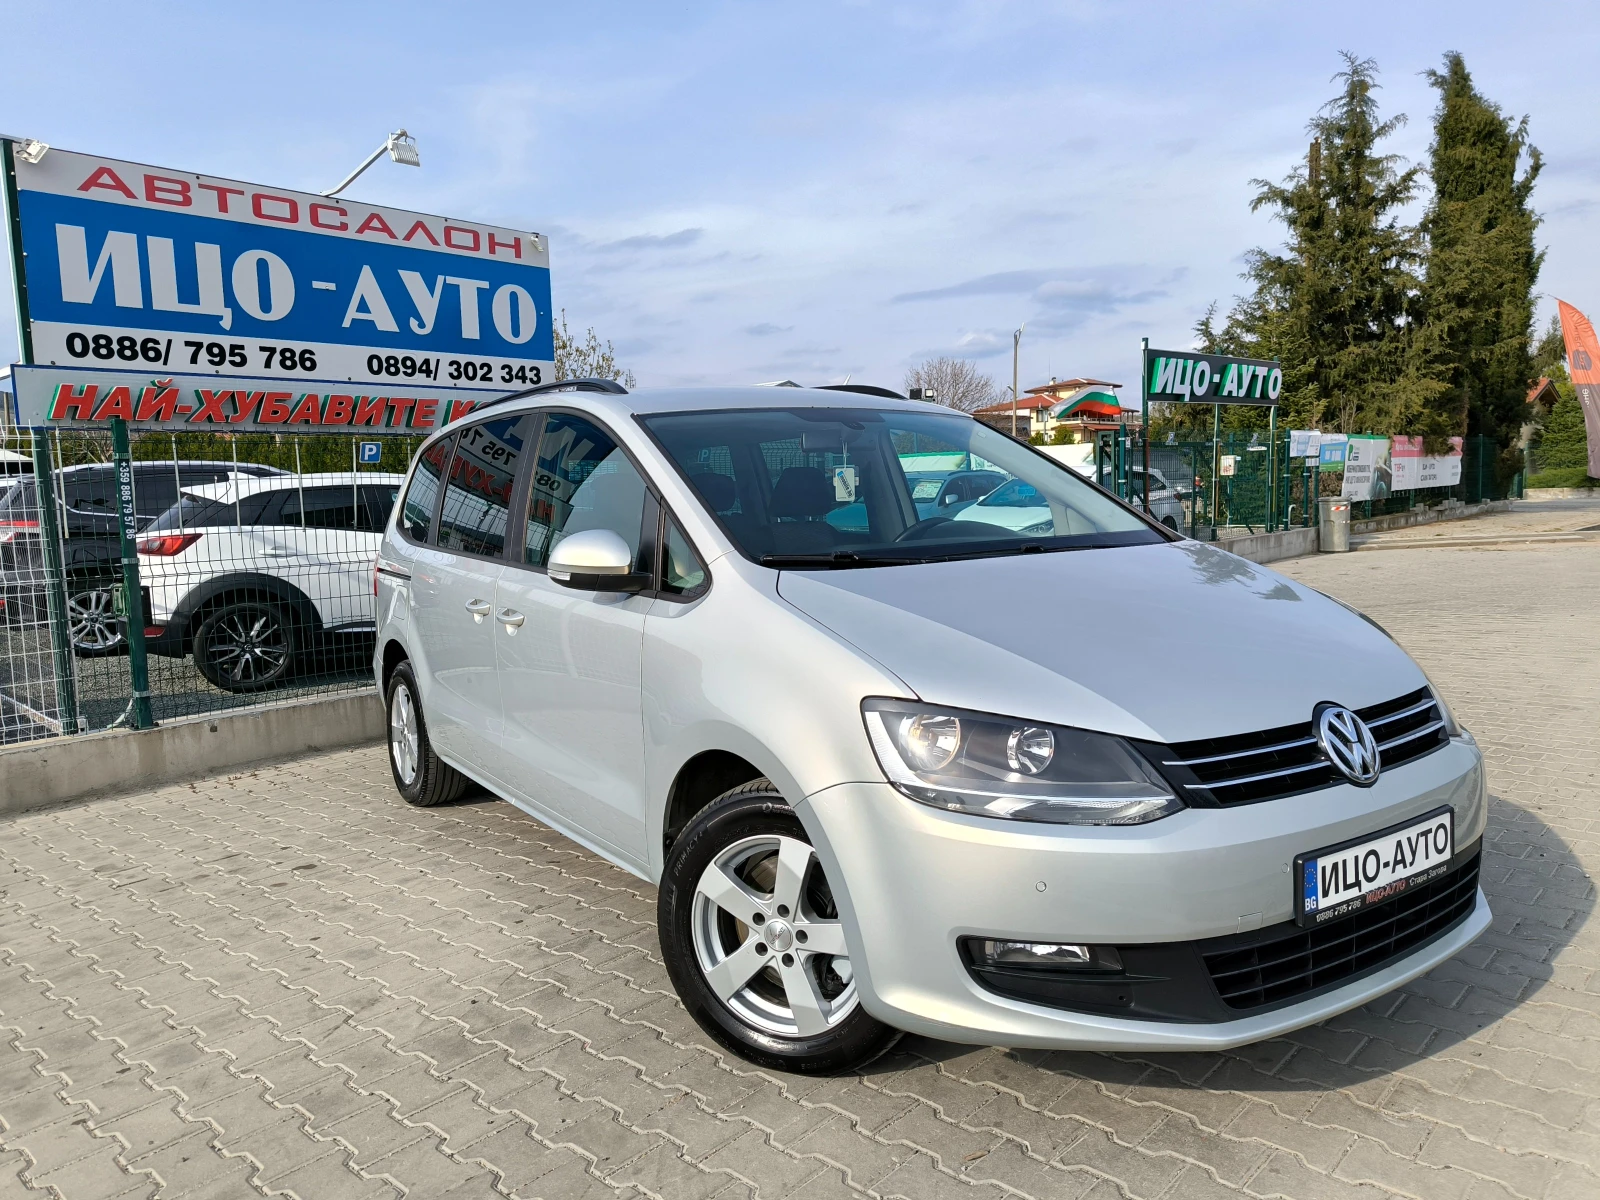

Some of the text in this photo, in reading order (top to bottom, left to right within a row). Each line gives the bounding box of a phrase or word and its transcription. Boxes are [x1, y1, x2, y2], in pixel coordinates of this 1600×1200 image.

[77, 166, 522, 259] АВТОСАЛОН
[65, 332, 318, 372] 0886/ 795 786
[366, 354, 542, 386] 0894/ 302 343
[49, 377, 439, 429] НАЙ-ХУБАВИТЕ
[120, 461, 136, 539] +359 886 79 57 86
[672, 834, 699, 876] PRIMACY
[1321, 823, 1449, 899] ИЦО-АУТО
[1305, 896, 1317, 911] BG
[1335, 904, 1348, 916] 795
[1348, 899, 1362, 911] 786
[1409, 873, 1428, 886] Стара
[1428, 865, 1447, 879] Загора
